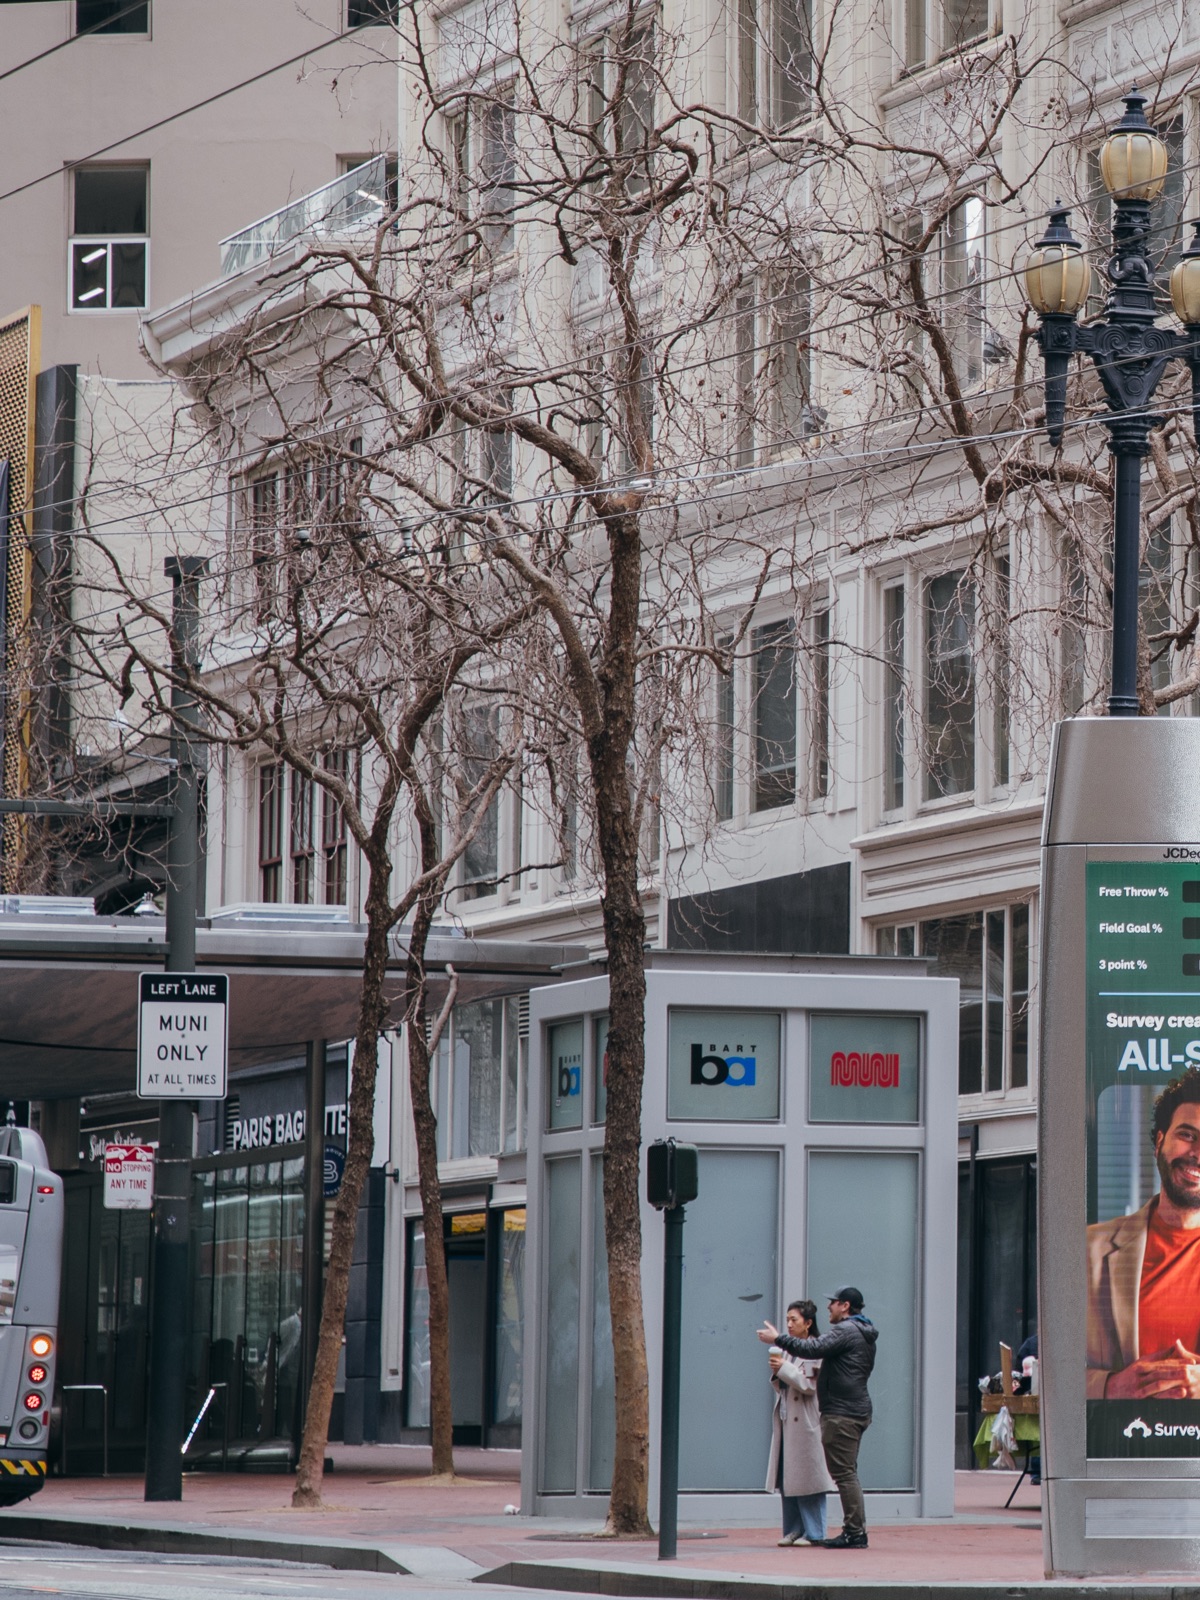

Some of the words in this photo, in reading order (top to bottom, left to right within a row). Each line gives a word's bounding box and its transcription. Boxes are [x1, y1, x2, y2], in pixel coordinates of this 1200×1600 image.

[1099, 887, 1122, 897] Free
[1124, 887, 1156, 897] Throw
[1158, 887, 1169, 897] %
[1099, 923, 1125, 933] Field
[1126, 923, 1150, 933] Goal
[1152, 924, 1163, 934] %
[1099, 960, 1106, 969] 3
[1107, 960, 1135, 972] point
[1136, 960, 1147, 970] %
[151, 983, 179, 995] LEFT
[184, 984, 217, 996] LANE
[160, 1015, 207, 1031] MUNI
[1106, 1012, 1165, 1032] Survey
[157, 1045, 208, 1061] ONLY
[709, 1044, 757, 1053] BART
[147, 1074, 159, 1084] AT
[164, 1074, 182, 1084] ALL
[187, 1074, 217, 1085] TIMES
[232, 1115, 273, 1151] PARIS
[275, 1104, 346, 1143] BAGTTE
[106, 1162, 121, 1171] NO
[122, 1164, 151, 1172] STOPPING
[110, 1180, 127, 1189] ANY
[129, 1180, 147, 1189] TIME
